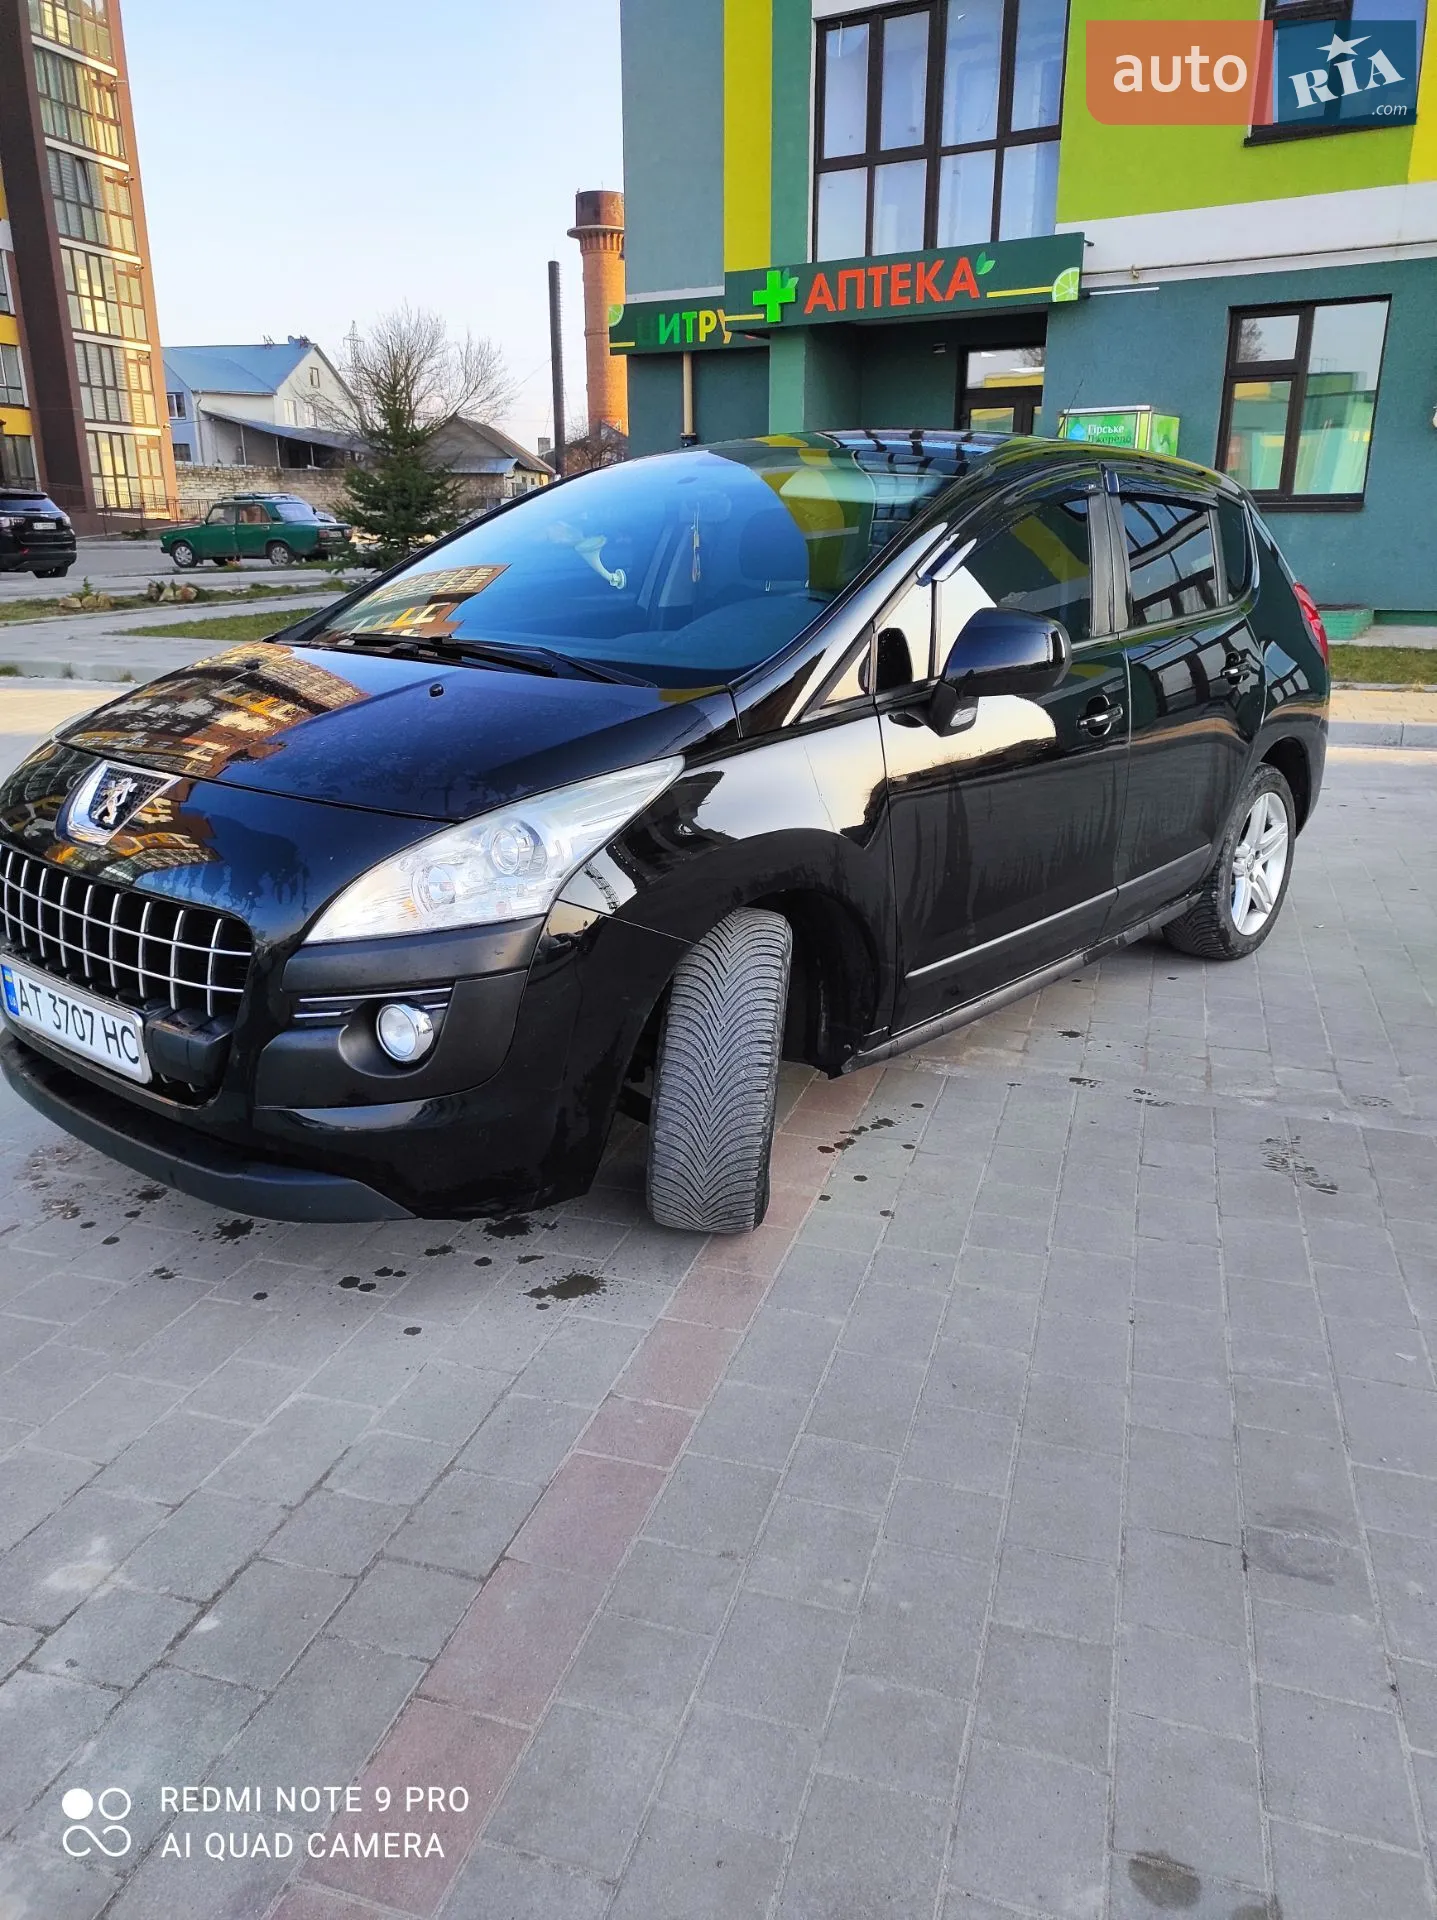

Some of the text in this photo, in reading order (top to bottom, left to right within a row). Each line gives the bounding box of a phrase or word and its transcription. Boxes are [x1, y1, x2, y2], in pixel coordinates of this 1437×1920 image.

[804, 256, 980, 314] АПТЕКА
[19, 978, 139, 1065] AT 3707 HC
